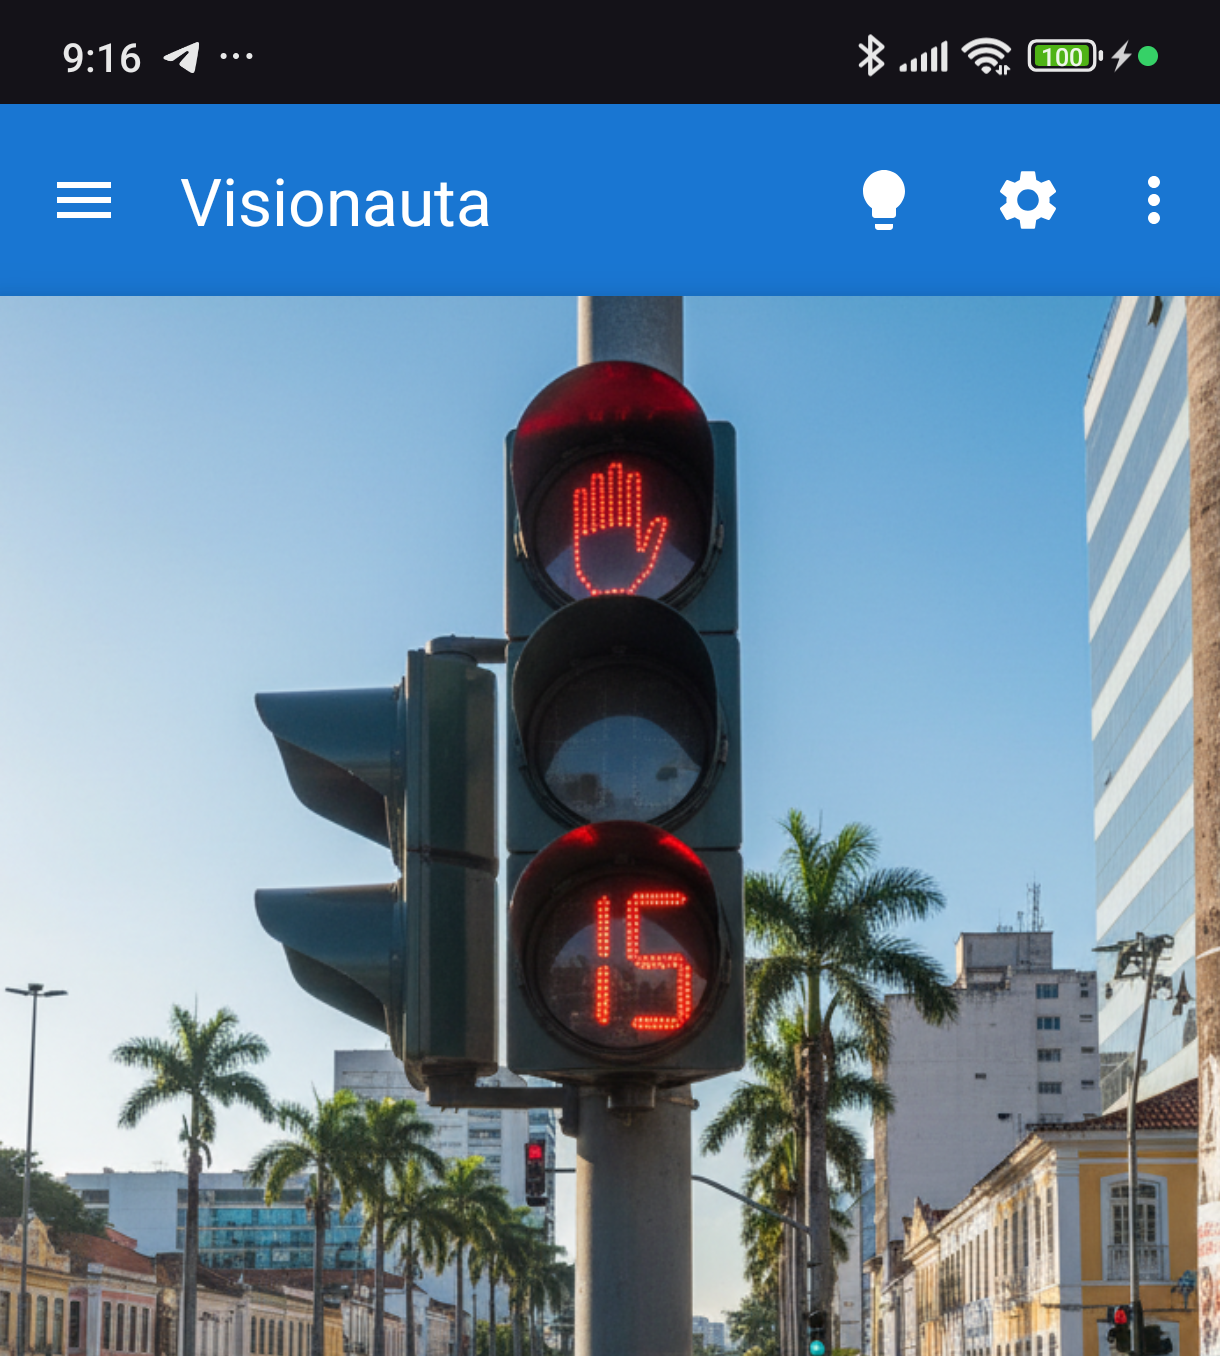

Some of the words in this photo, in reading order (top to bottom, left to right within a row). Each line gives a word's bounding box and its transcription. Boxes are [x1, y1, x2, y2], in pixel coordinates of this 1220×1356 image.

[63, 43, 141, 73] 9:16
[1042, 47, 1083, 67] 100
[181, 178, 489, 227] Visionauta
[595, 891, 692, 1030] 15
